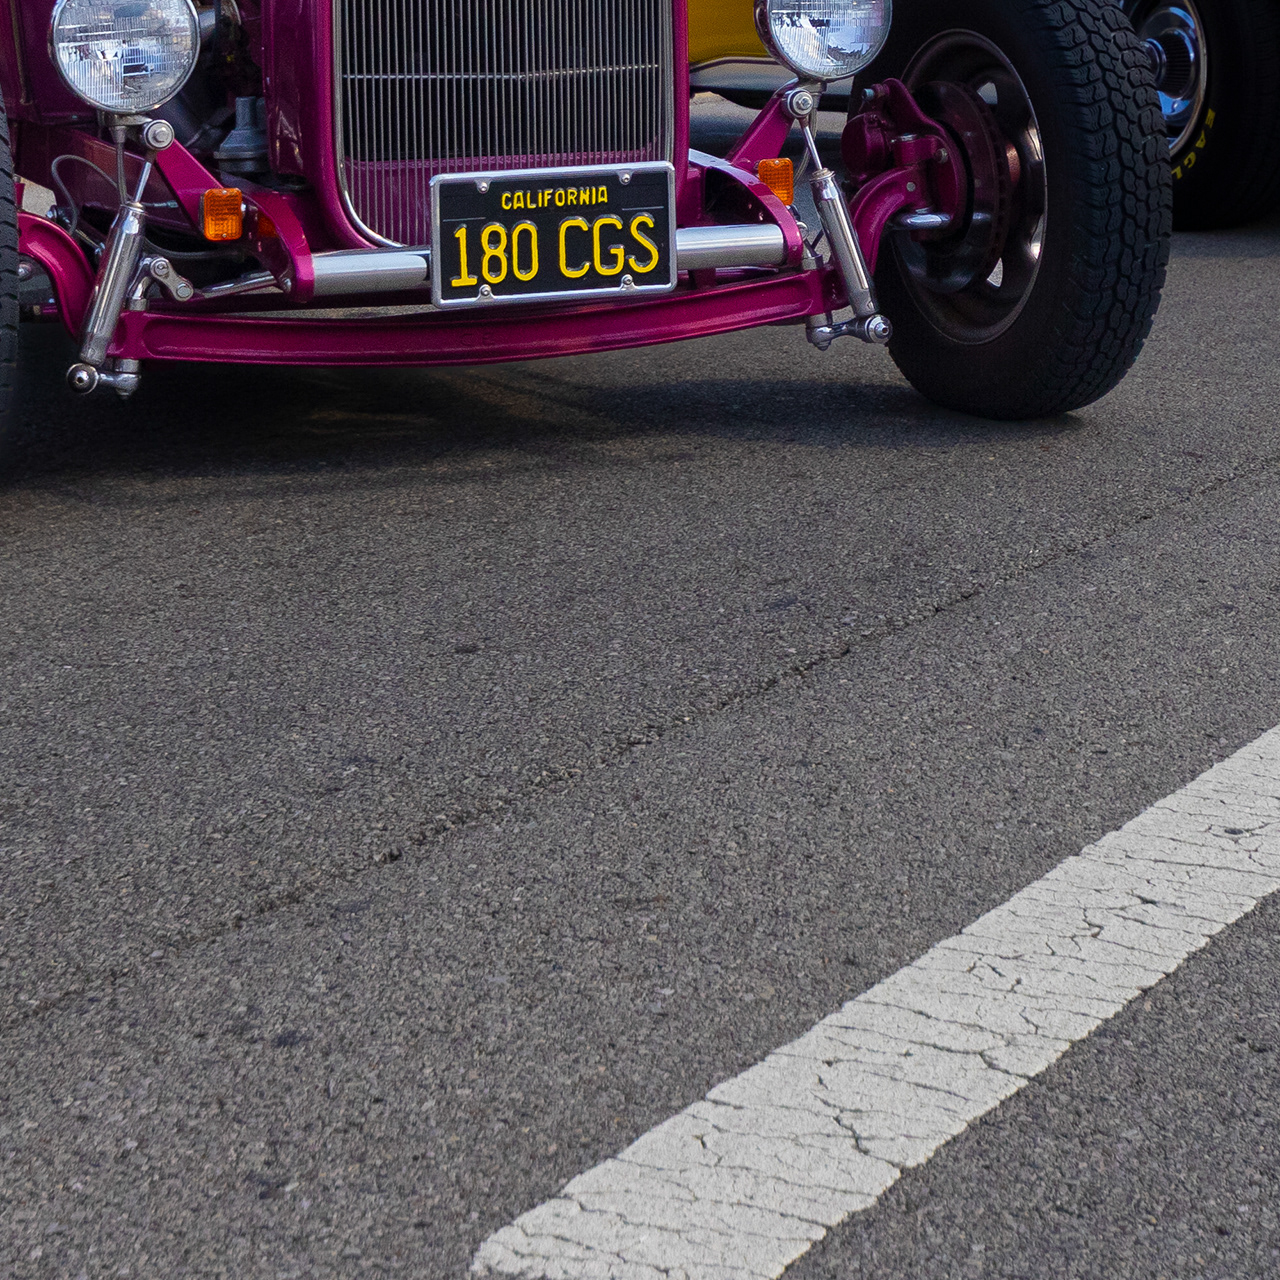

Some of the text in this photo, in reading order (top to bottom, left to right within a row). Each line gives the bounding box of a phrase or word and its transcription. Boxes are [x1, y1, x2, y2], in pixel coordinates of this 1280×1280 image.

[501, 185, 608, 210] CALIFORNIA
[450, 211, 659, 287] 180 CGS
